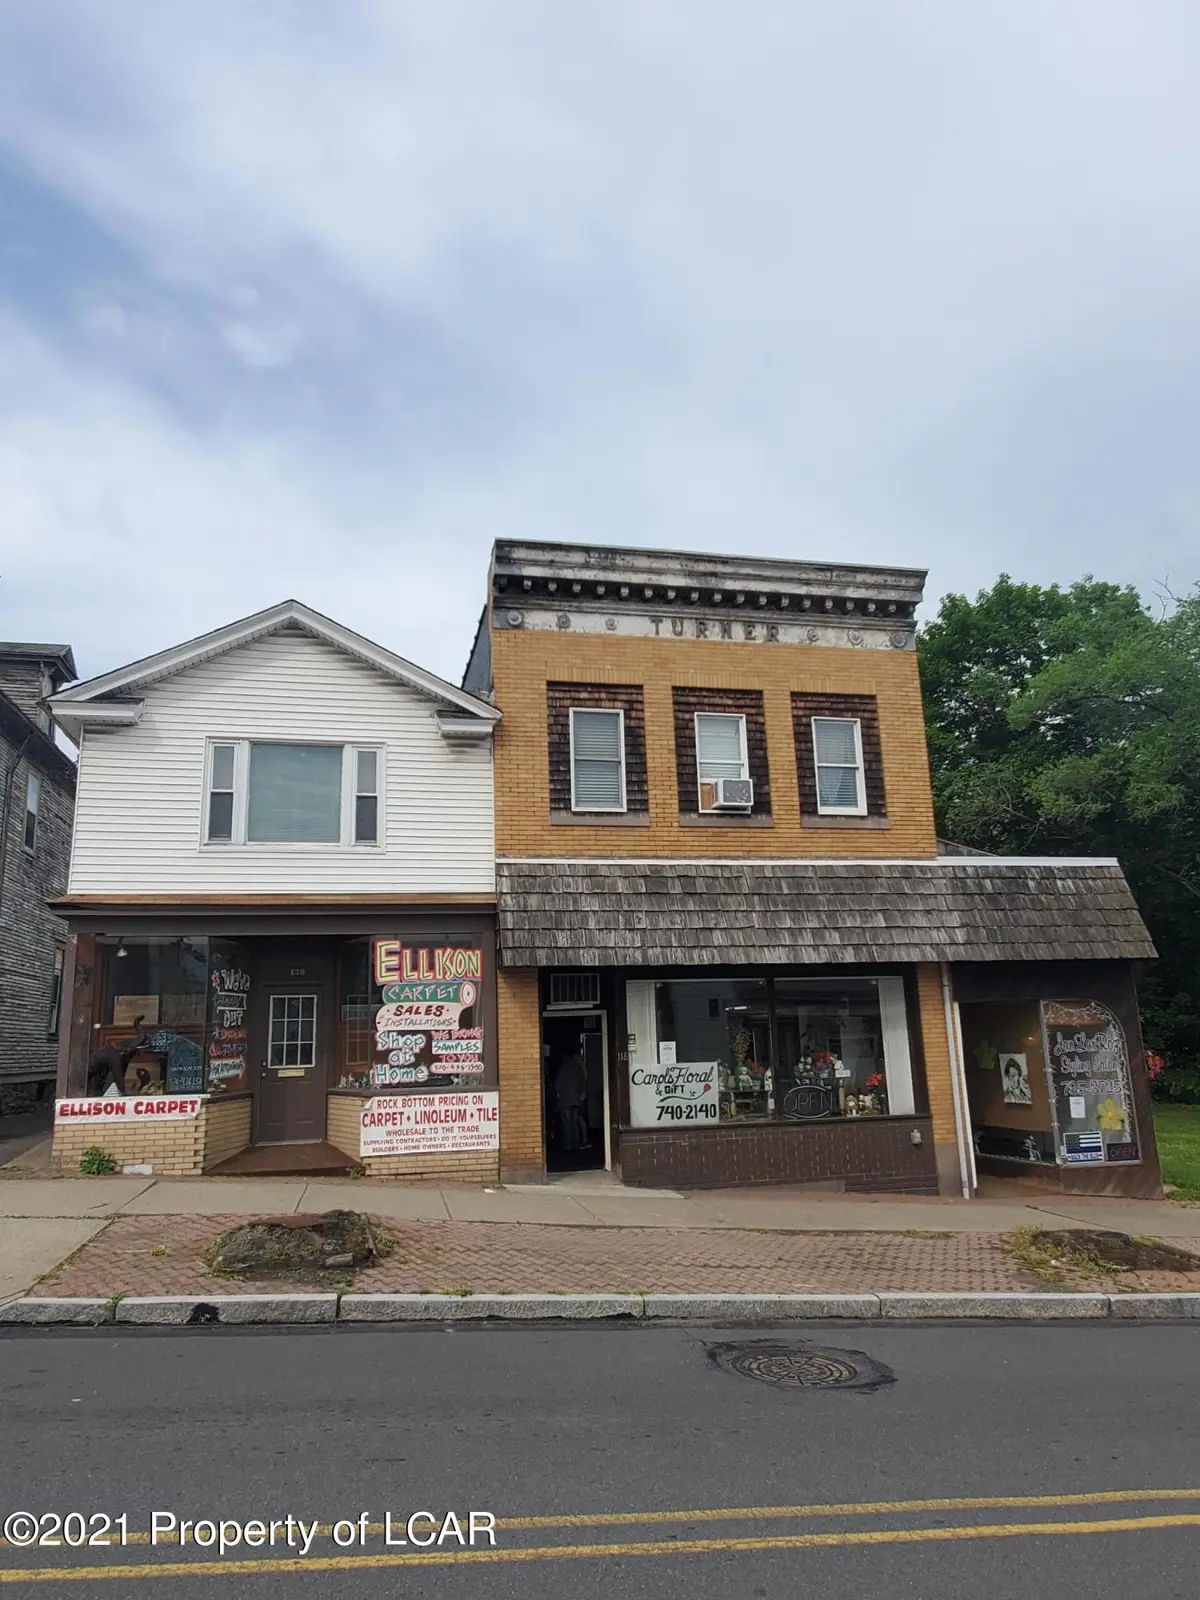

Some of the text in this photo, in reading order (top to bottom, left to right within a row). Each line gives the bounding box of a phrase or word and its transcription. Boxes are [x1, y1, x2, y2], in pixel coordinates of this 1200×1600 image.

[651, 617, 780, 642] TURNER
[376, 940, 482, 982] ELLISON
[388, 984, 457, 1001] CARPET
[393, 1005, 445, 1016] SALES
[384, 1017, 453, 1028] INSTALLATIONS
[376, 1030, 426, 1053] Shop
[431, 1029, 450, 1040] WE
[434, 1041, 480, 1054] SAMPLES
[375, 1064, 429, 1085] Home
[669, 1066, 714, 1086] Floral
[59, 1100, 198, 1117] ELLISON CARPET
[377, 1095, 483, 1109] ROCK BOTTOM PRICING ON
[784, 1091, 833, 1112] OPEN
[362, 1107, 497, 1127] CARPET LINOLEUM TILE
[656, 1103, 717, 1121] 740-2140
[386, 1125, 480, 1137] WHOLESALE TO THE TRADE
[396, 1137, 437, 1145] CONTRACTORS
[404, 1144, 420, 1152] HOME
